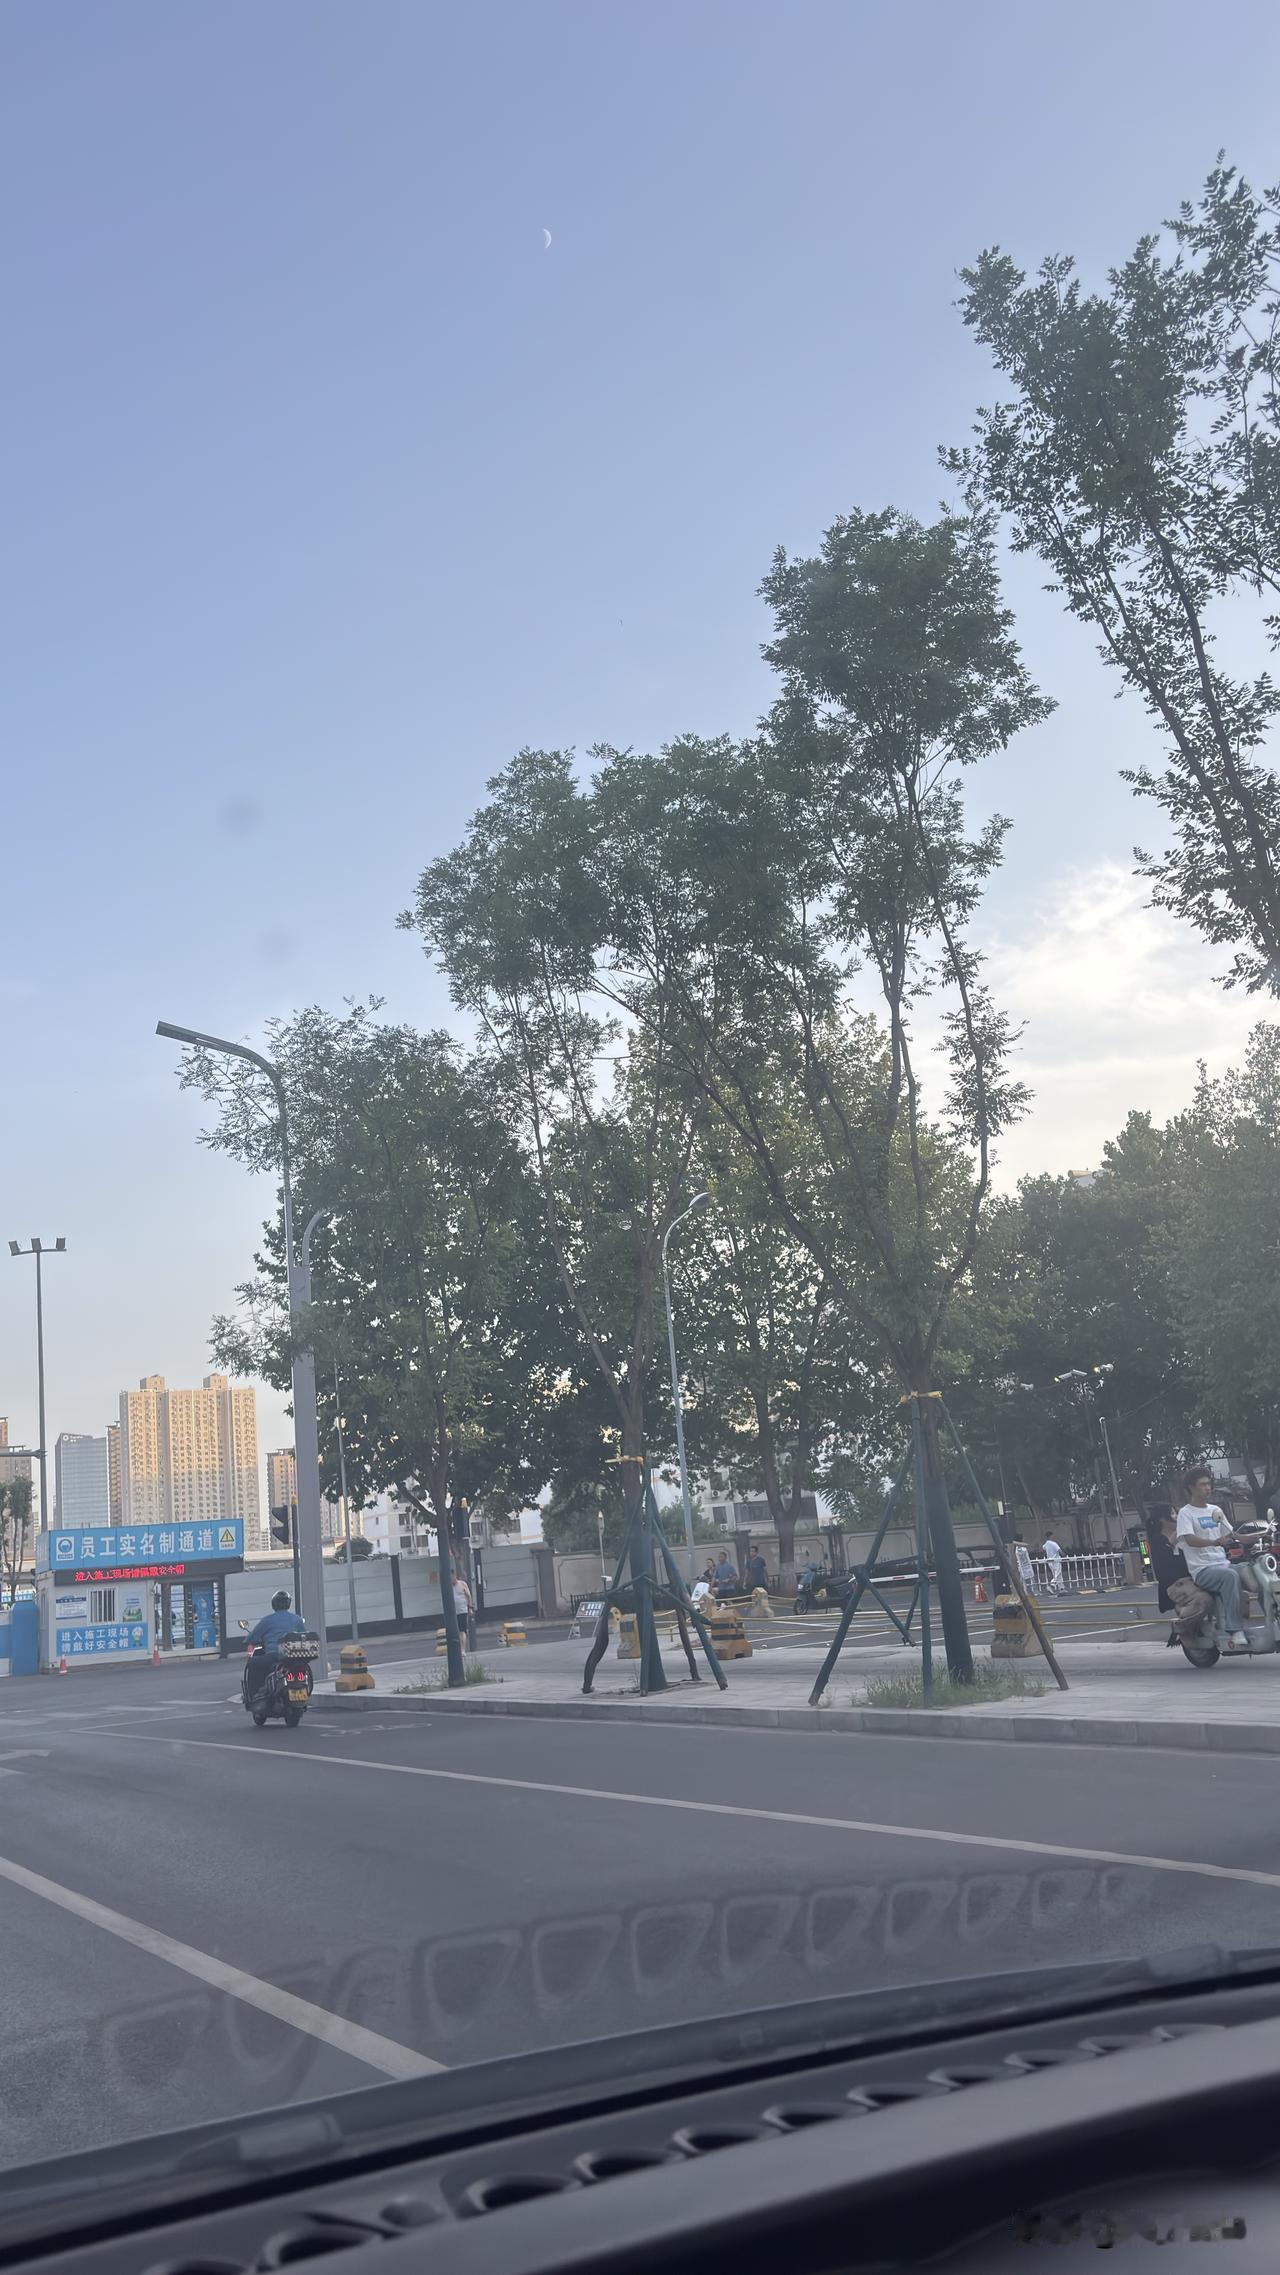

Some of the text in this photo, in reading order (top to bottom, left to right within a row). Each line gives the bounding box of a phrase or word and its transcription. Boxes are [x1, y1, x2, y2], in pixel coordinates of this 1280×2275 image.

[80, 1529, 214, 1559] 员工实名制通道
[61, 1627, 129, 1642] 进入施工现场
[61, 1638, 129, 1653] 请戴好安全帽
